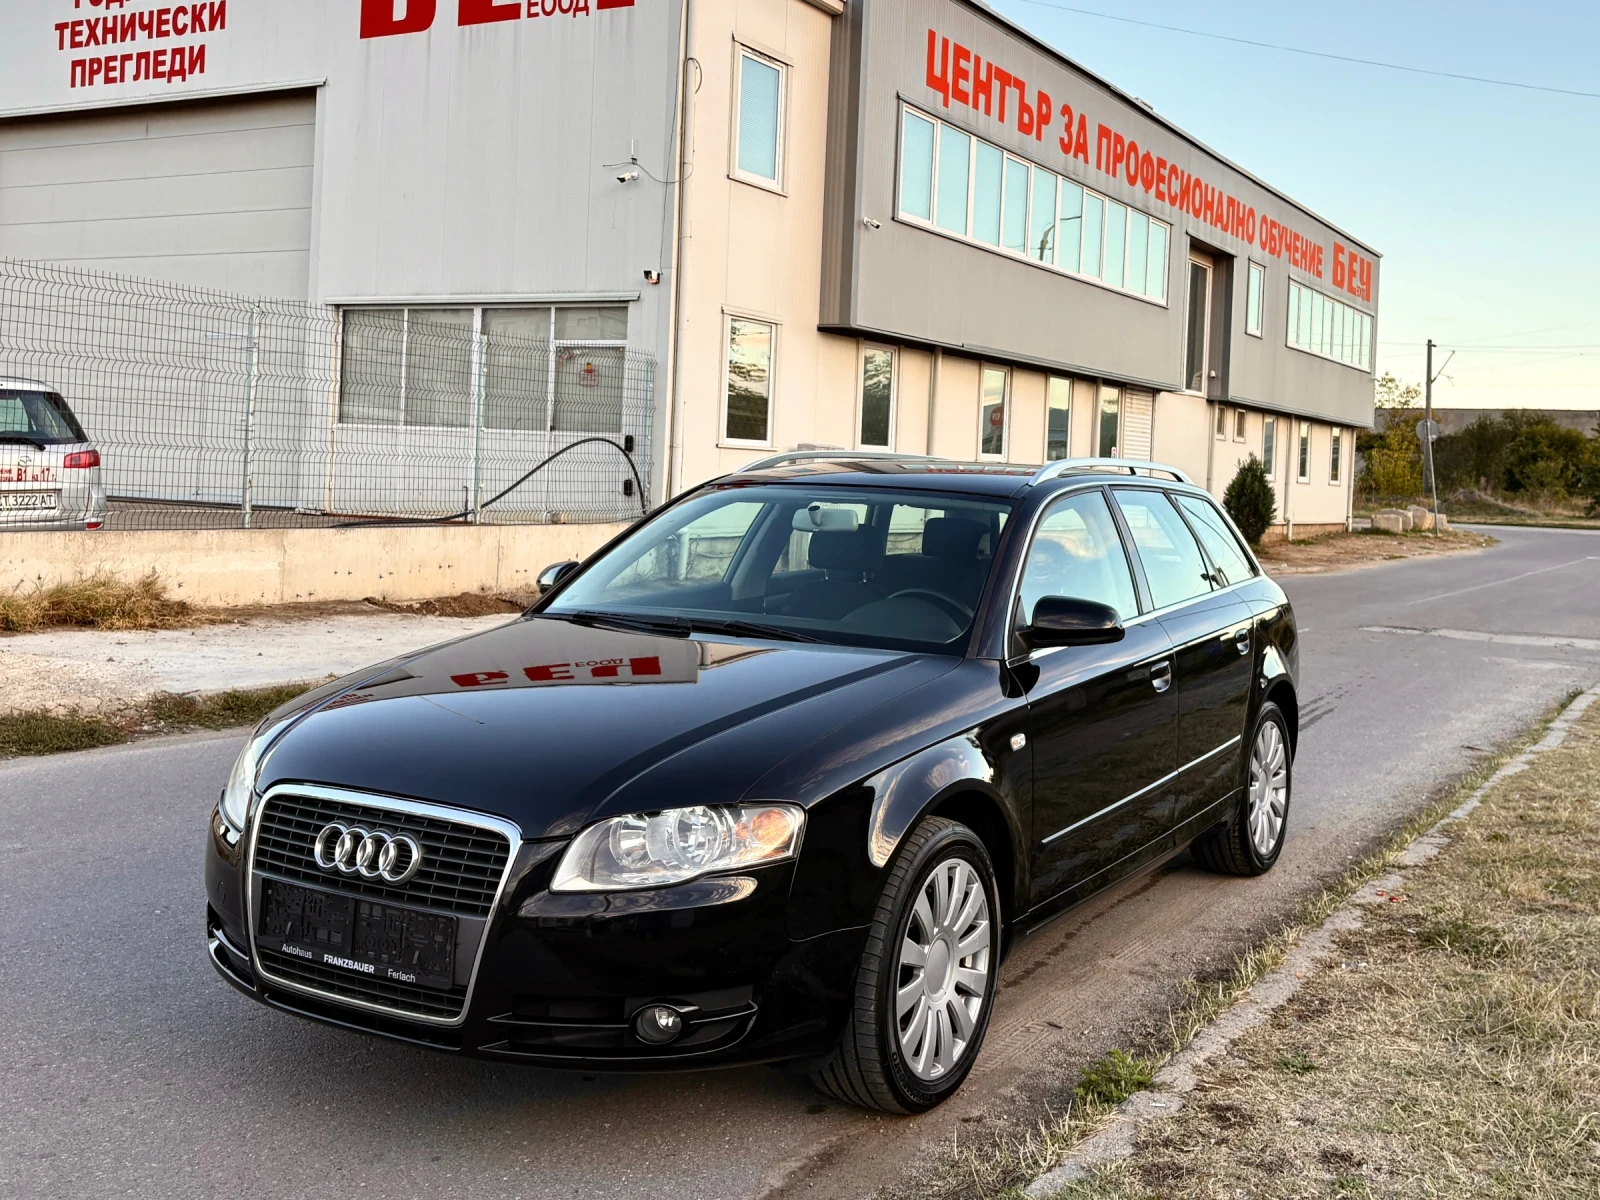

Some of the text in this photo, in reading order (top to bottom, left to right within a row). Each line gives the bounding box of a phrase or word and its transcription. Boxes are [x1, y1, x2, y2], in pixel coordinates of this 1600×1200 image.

[54, 0, 227, 51] ТЕХНИЧЕСКИ
[70, 44, 206, 88] ПРЕГЛЕДИ
[925, 28, 1373, 303] ЦЕНТЪР ЗА ПРОФЕСИОНАЛНО ОБУЧЕНИЕ БЕЧ
[281, 943, 416, 983] Autohaus FRANZBAUER Ferlach
